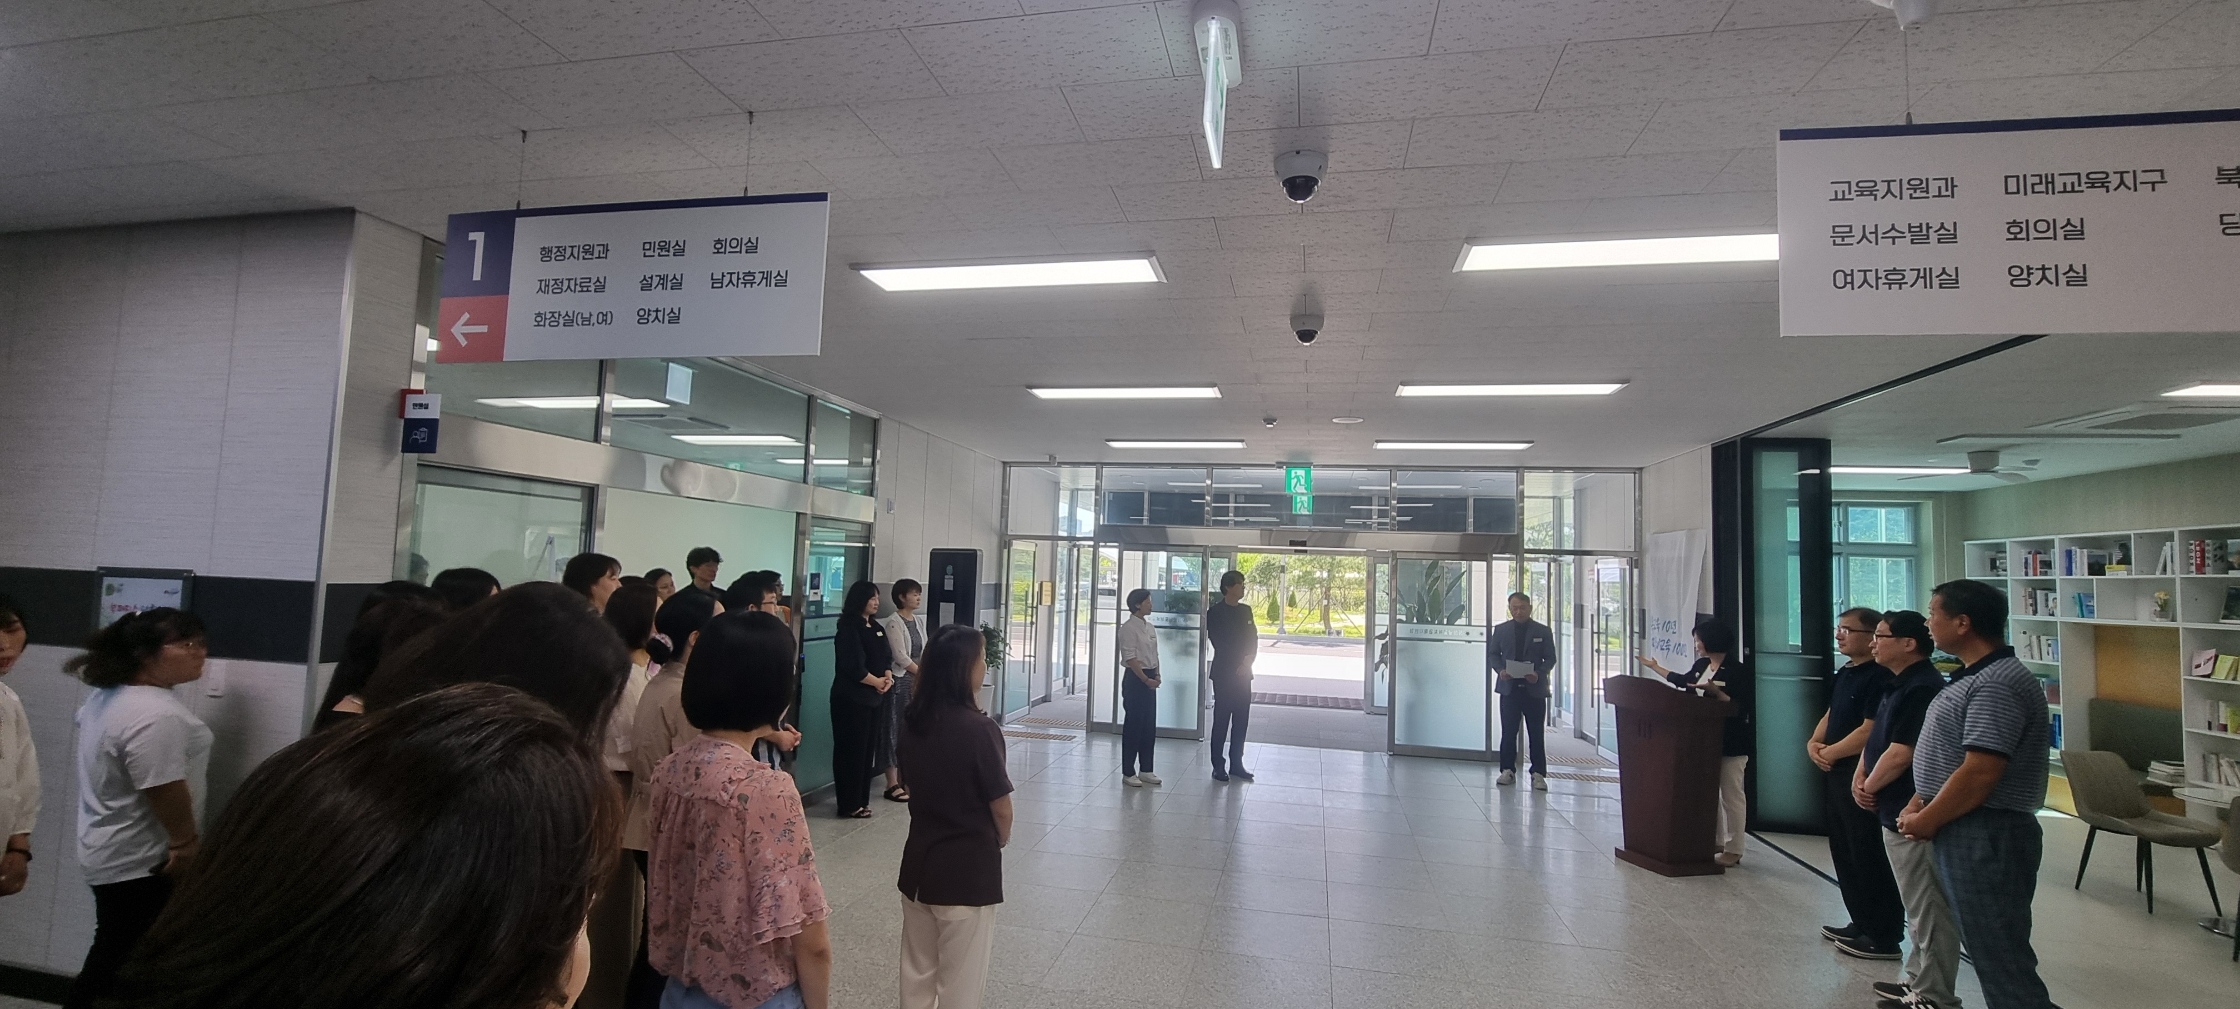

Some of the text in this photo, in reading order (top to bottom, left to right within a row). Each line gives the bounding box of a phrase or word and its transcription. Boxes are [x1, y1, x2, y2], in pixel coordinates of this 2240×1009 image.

[1828, 176, 1959, 202] 교육지원과
[2003, 168, 2168, 197] 미래교육지구
[1829, 220, 1959, 247] 문서수발실
[2005, 217, 2086, 242] 회의실
[468, 231, 485, 281] 1
[539, 236, 759, 263] 행정지원과 민원실 회의실
[535, 269, 789, 296] 재정자료실 설계실 남자휴게실
[1832, 263, 2088, 291] 여자휴게실 양치실
[533, 306, 682, 329] 화장실(남,여) 양치실
